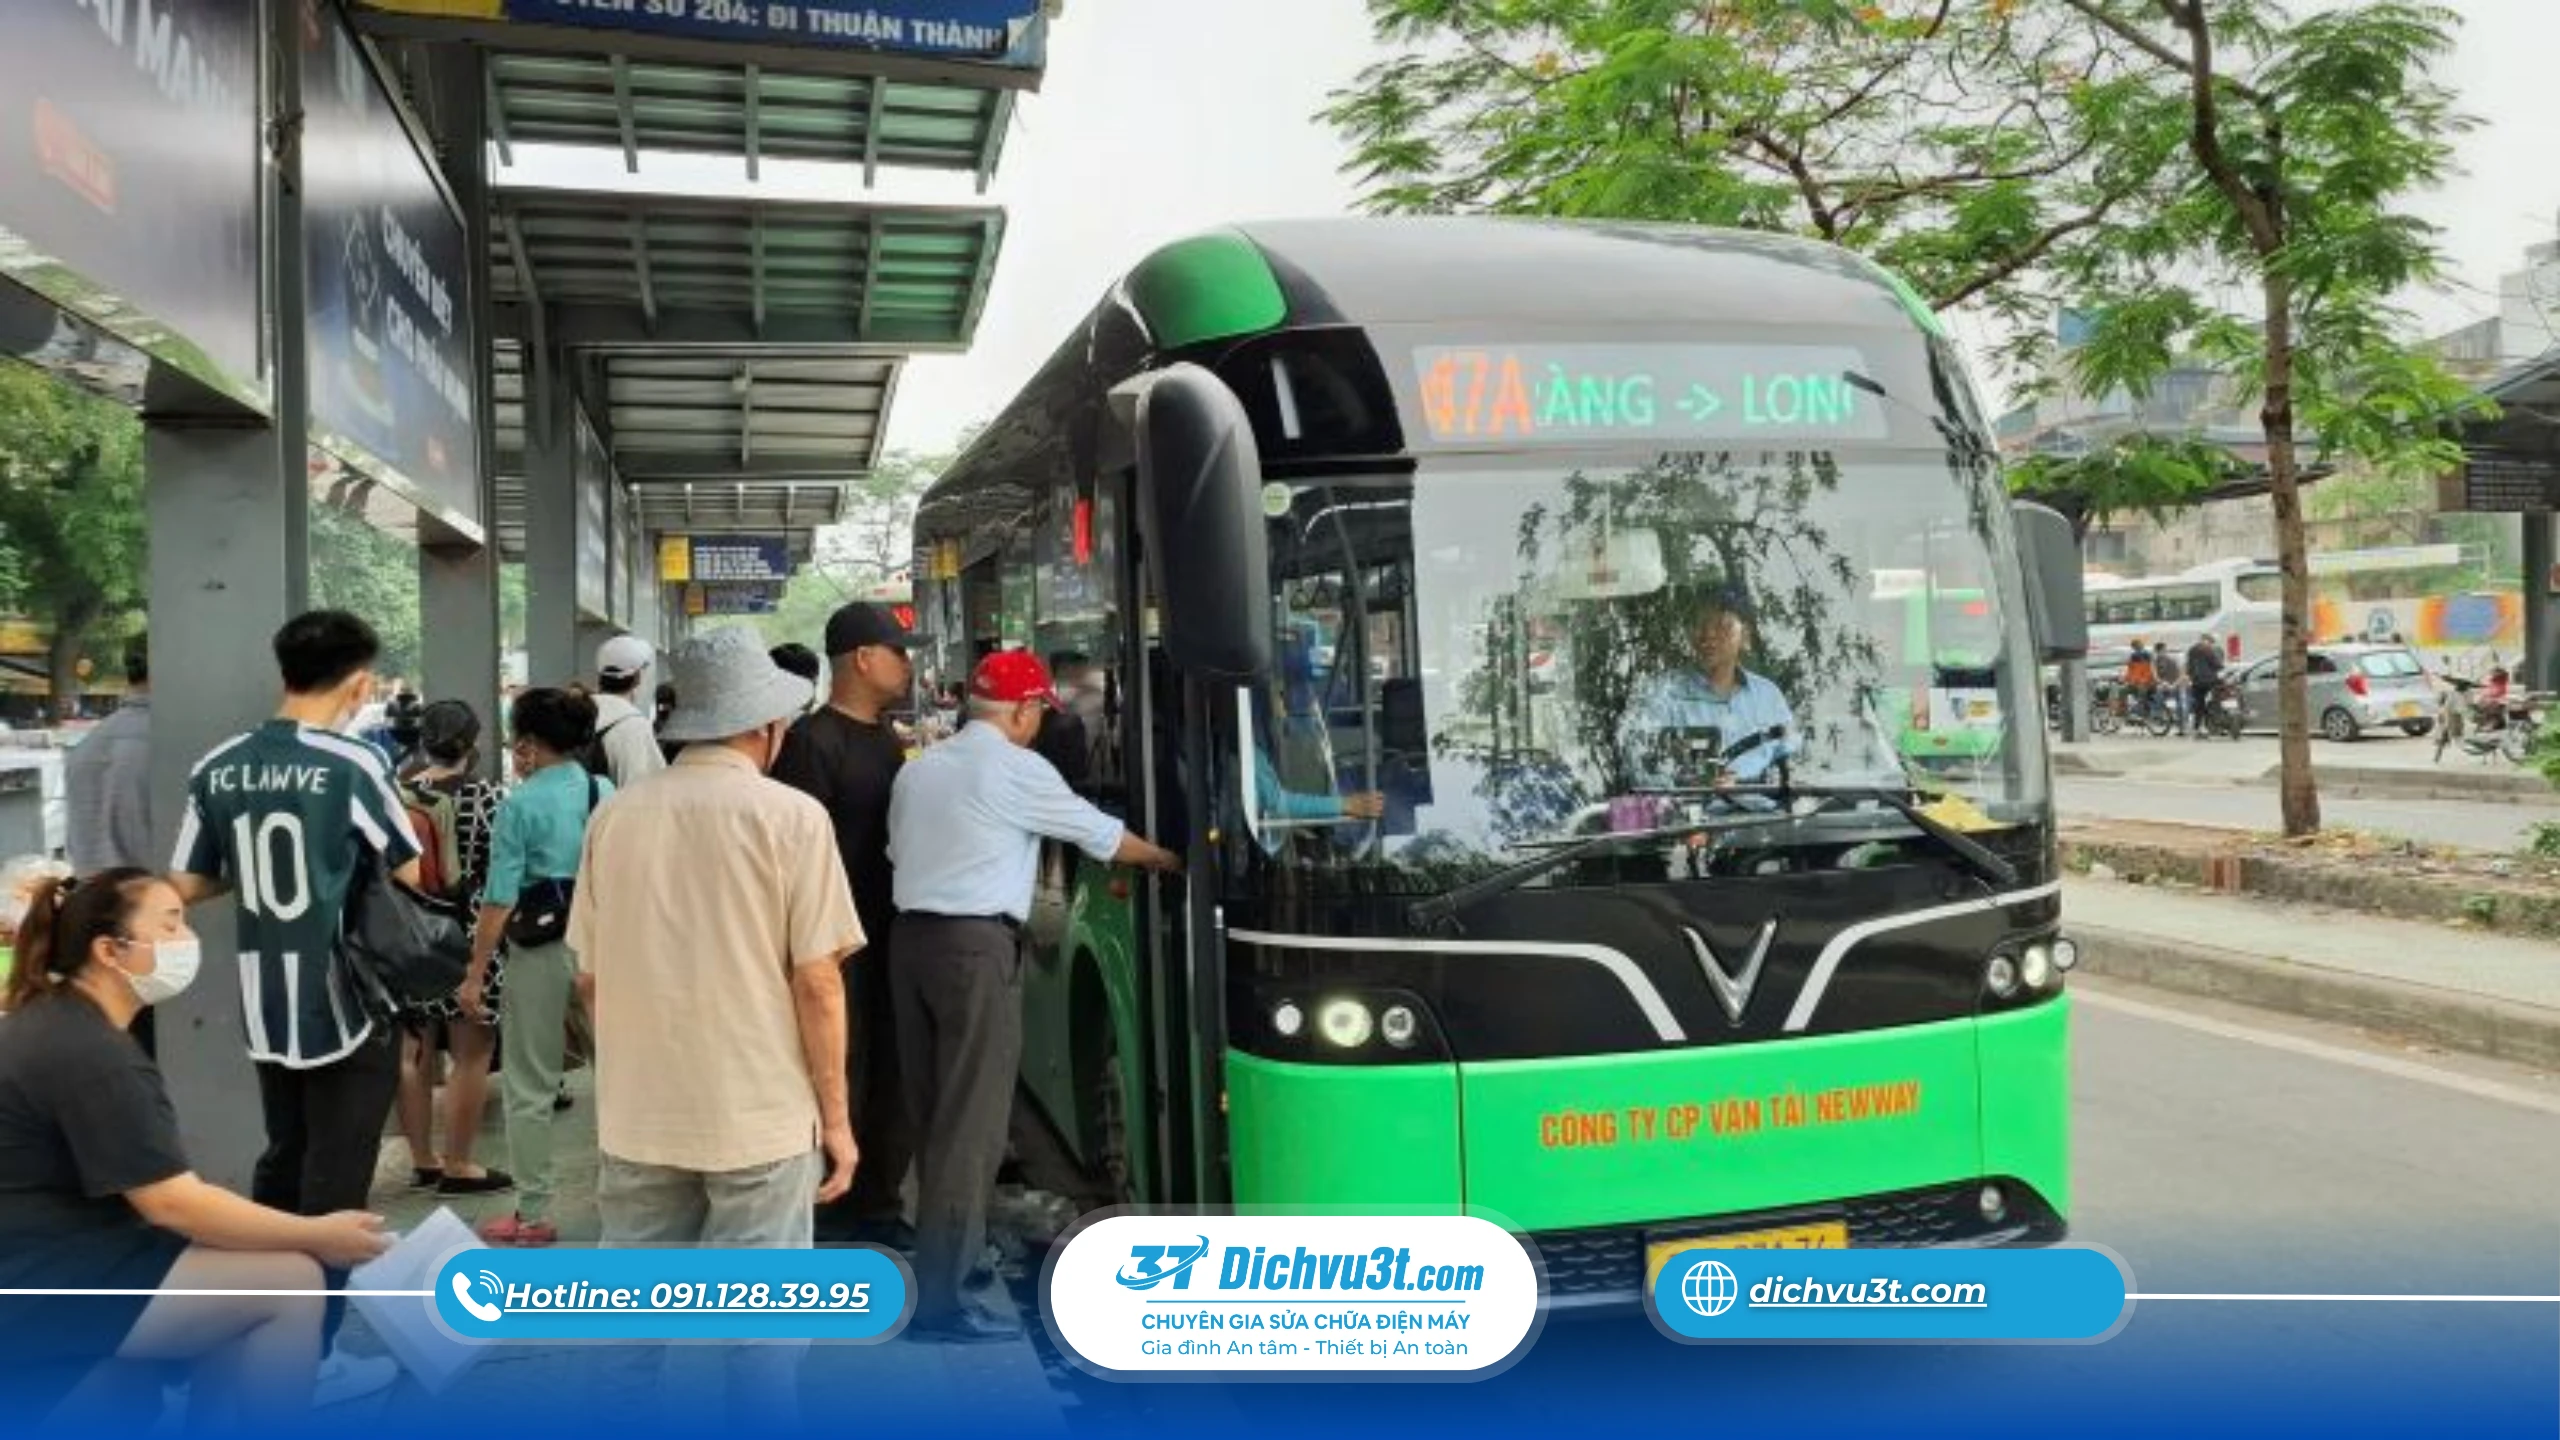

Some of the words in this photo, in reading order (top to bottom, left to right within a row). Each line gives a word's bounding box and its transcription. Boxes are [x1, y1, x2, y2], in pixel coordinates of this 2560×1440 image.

[1536, 361, 1656, 427] ÀNG
[210, 764, 236, 794] FC
[232, 811, 311, 921] 10
[1626, 1106, 1656, 1142] TY
[1666, 1104, 1700, 1138] CP
[1815, 1081, 1921, 1123] NEWWAY
